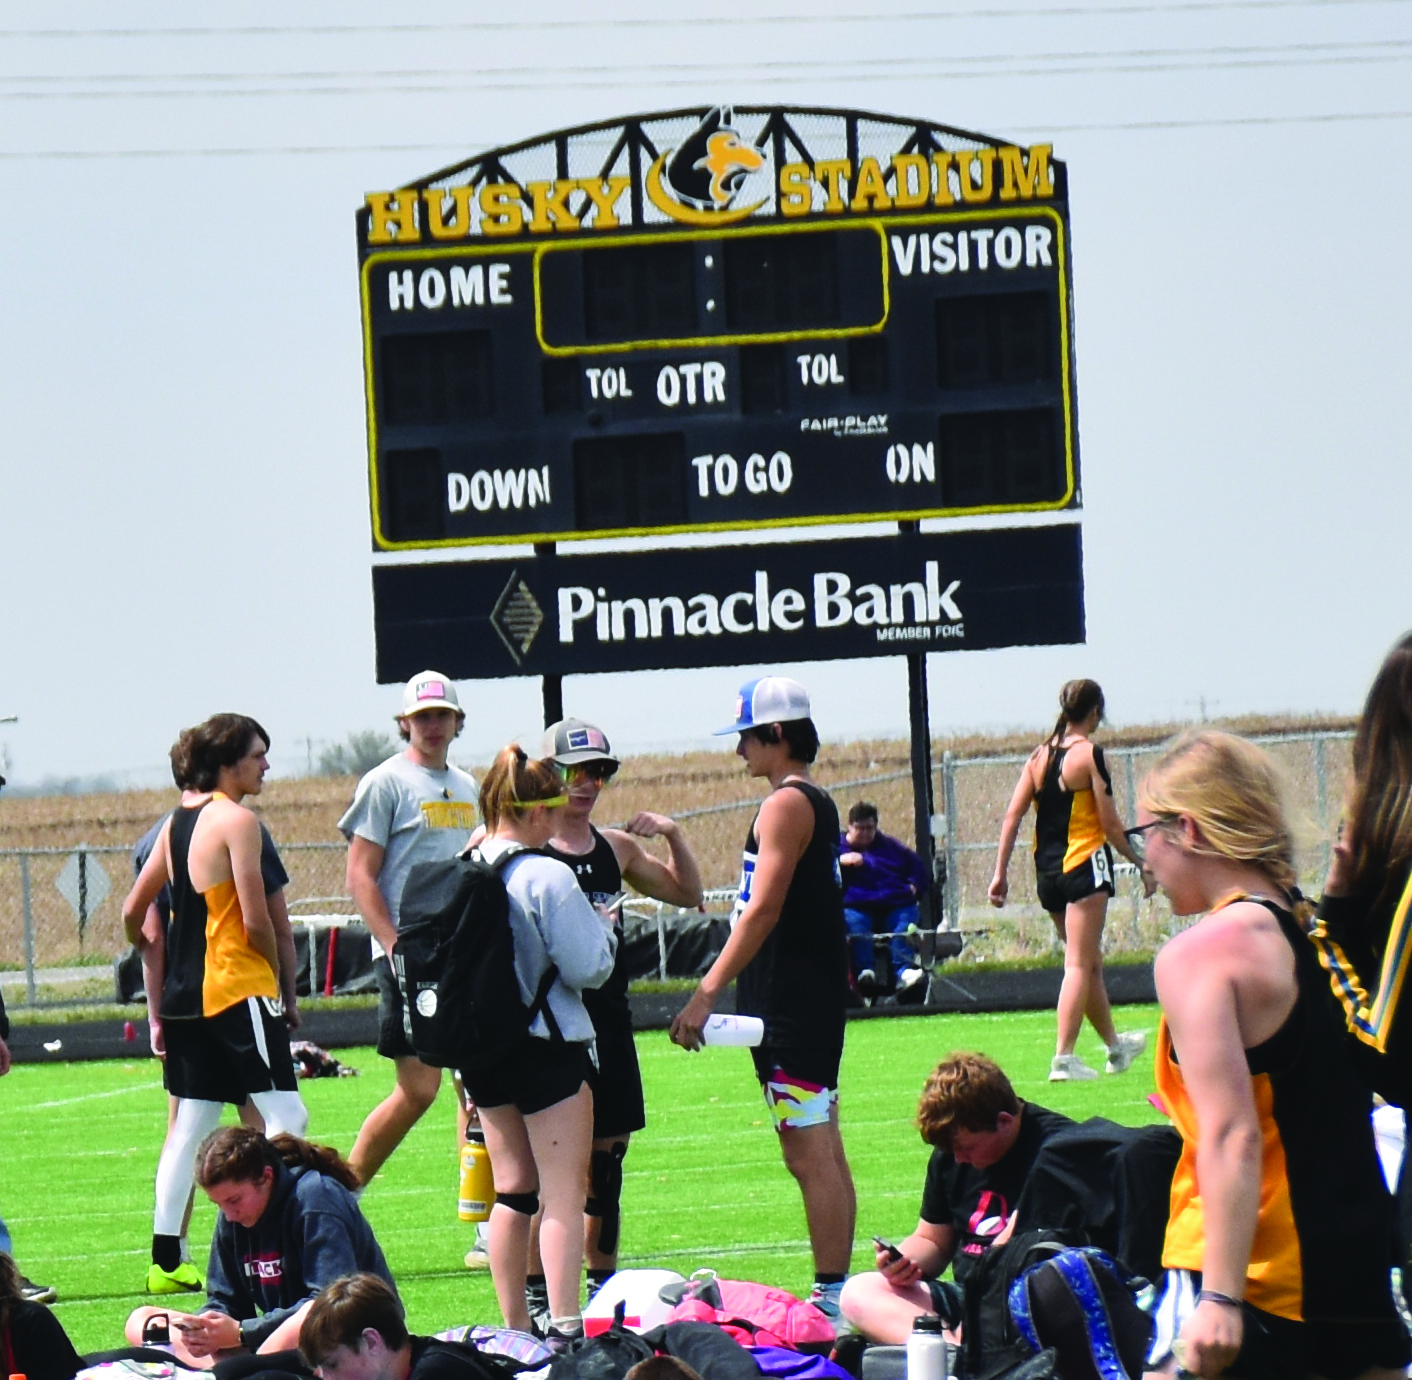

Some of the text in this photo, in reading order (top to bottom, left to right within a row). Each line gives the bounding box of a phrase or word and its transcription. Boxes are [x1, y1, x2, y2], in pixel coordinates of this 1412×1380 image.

[365, 143, 1054, 243] HUSKY STADIUM
[891, 224, 1053, 276] VISITOR
[388, 262, 514, 311] HOME
[586, 367, 633, 399] TOL
[796, 353, 845, 386] TOL
[886, 441, 936, 484] ON
[447, 464, 552, 513] DOWN
[558, 560, 963, 642] Pinnacle Bank
[877, 626, 931, 641] MEMBER
[1094, 850, 1106, 872] 6
